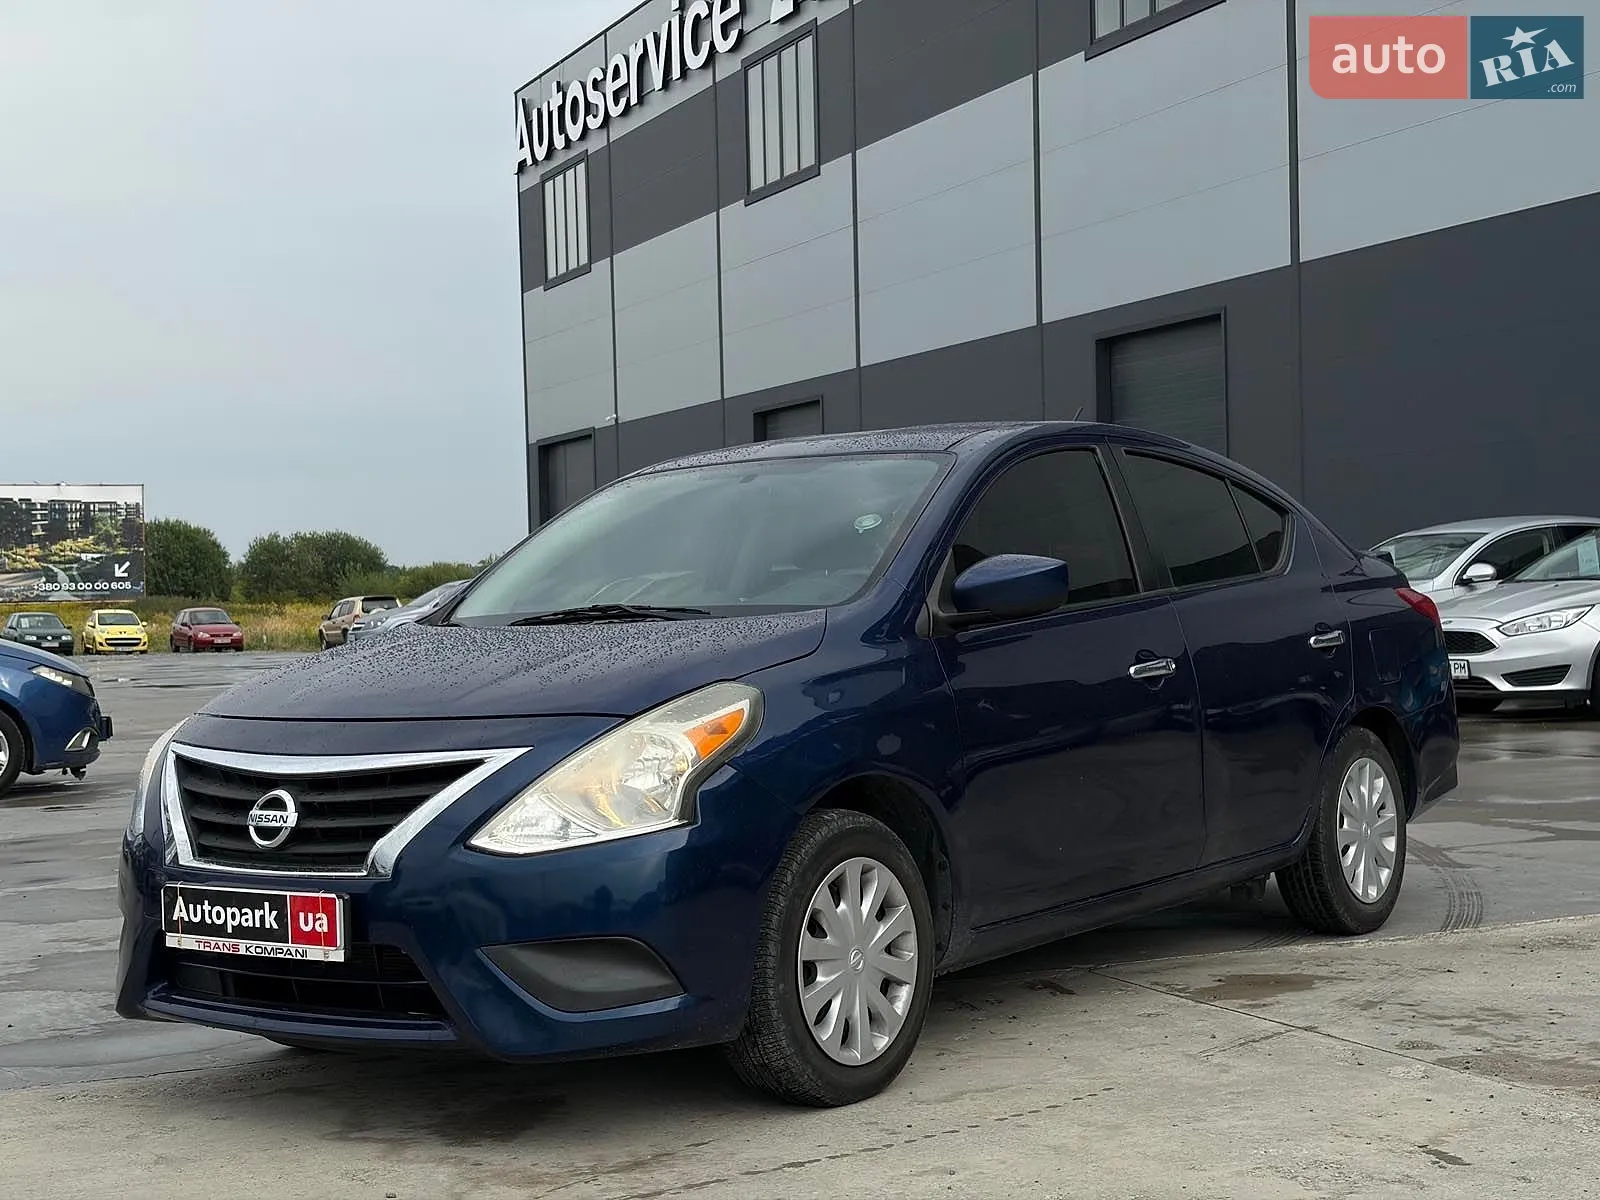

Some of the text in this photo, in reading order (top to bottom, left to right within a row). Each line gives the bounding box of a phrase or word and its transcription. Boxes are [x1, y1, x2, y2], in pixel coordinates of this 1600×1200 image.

[514, 0, 742, 173] Autoservice
[77, 582, 93, 590] 00
[94, 582, 110, 590] 00
[110, 582, 132, 590] 605
[248, 813, 289, 824] NISSAN
[172, 896, 328, 933] Autopark ua
[194, 940, 308, 959] TRANS KOMPANI
